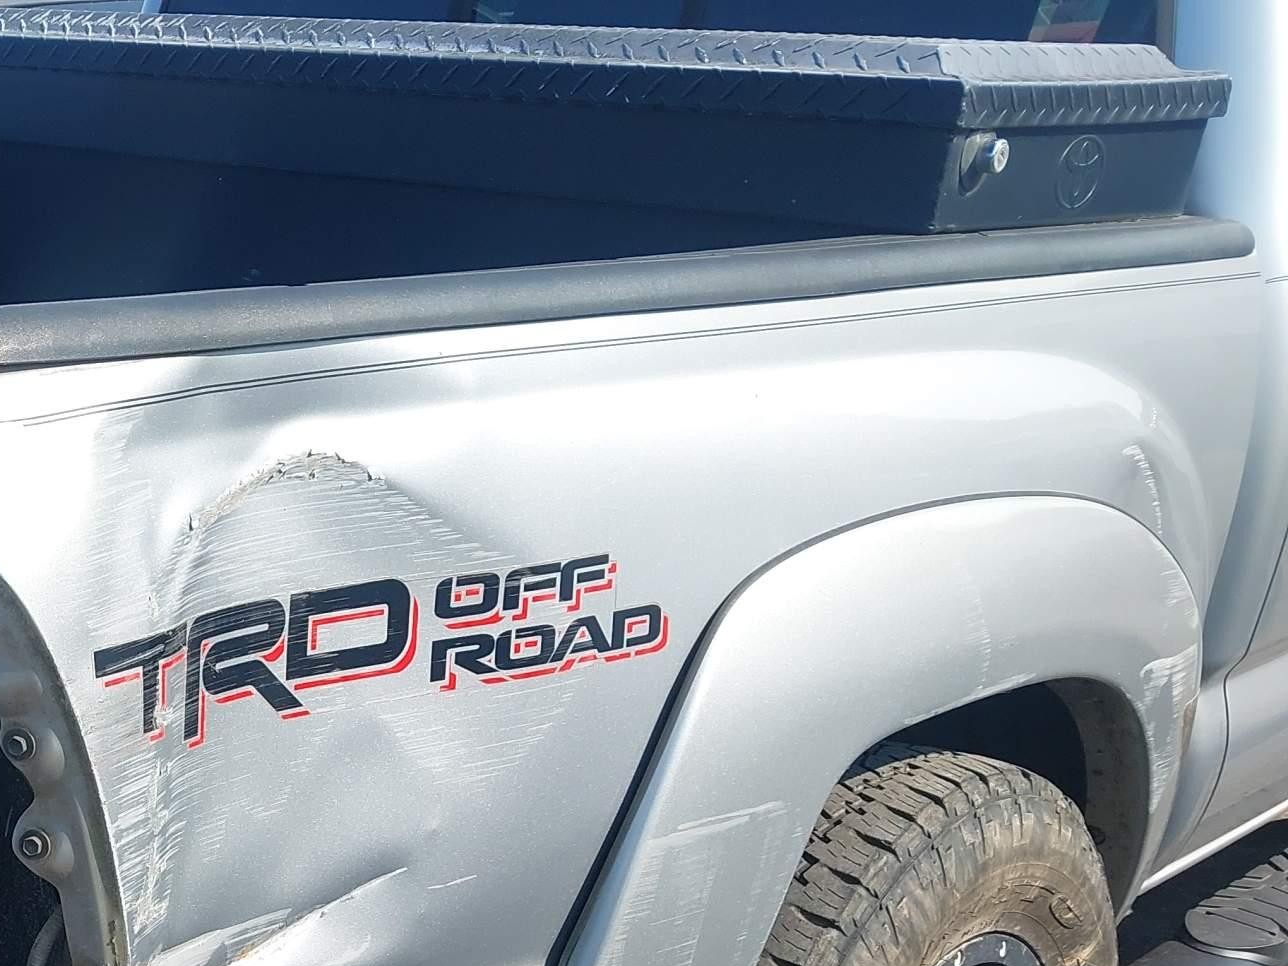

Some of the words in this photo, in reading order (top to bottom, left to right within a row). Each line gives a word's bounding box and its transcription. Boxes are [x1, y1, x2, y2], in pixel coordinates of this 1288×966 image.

[434, 554, 617, 630] OFF
[93, 578, 420, 748] TRD
[430, 604, 669, 692] ROAD
